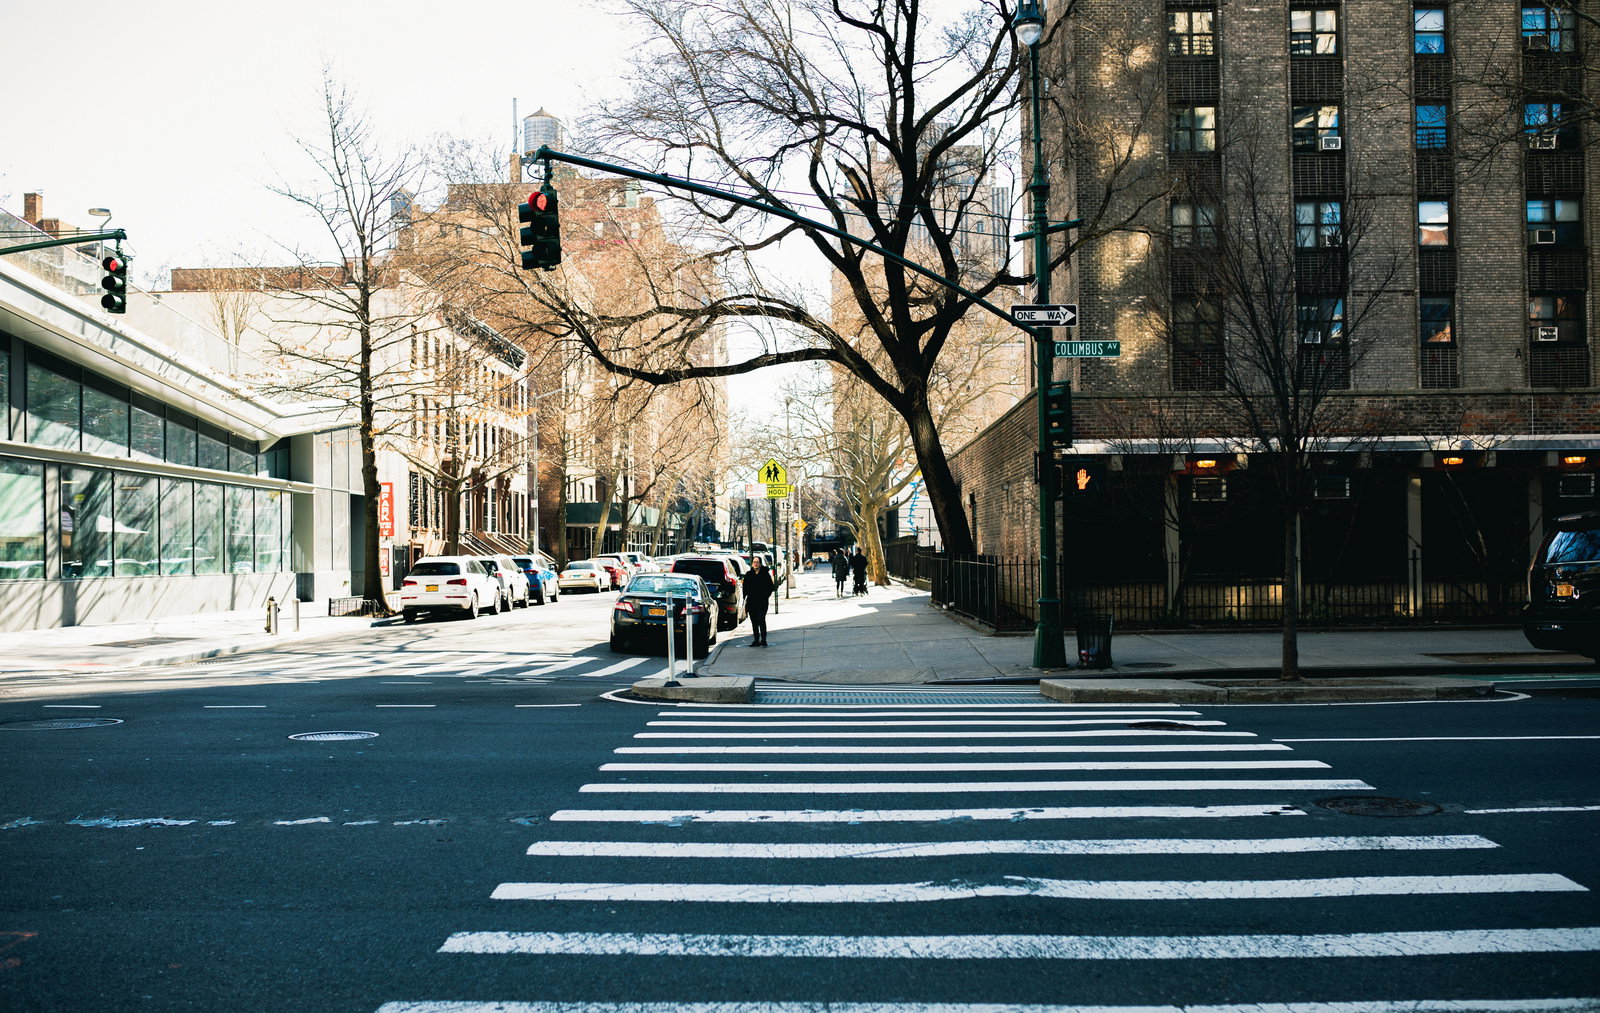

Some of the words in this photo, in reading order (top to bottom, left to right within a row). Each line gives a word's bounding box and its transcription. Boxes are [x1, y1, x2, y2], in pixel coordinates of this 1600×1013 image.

[1016, 311, 1036, 320] ONE
[1047, 311, 1068, 320] WAY
[1055, 343, 1103, 355] COLUMBUS
[381, 493, 389, 521] PARK
